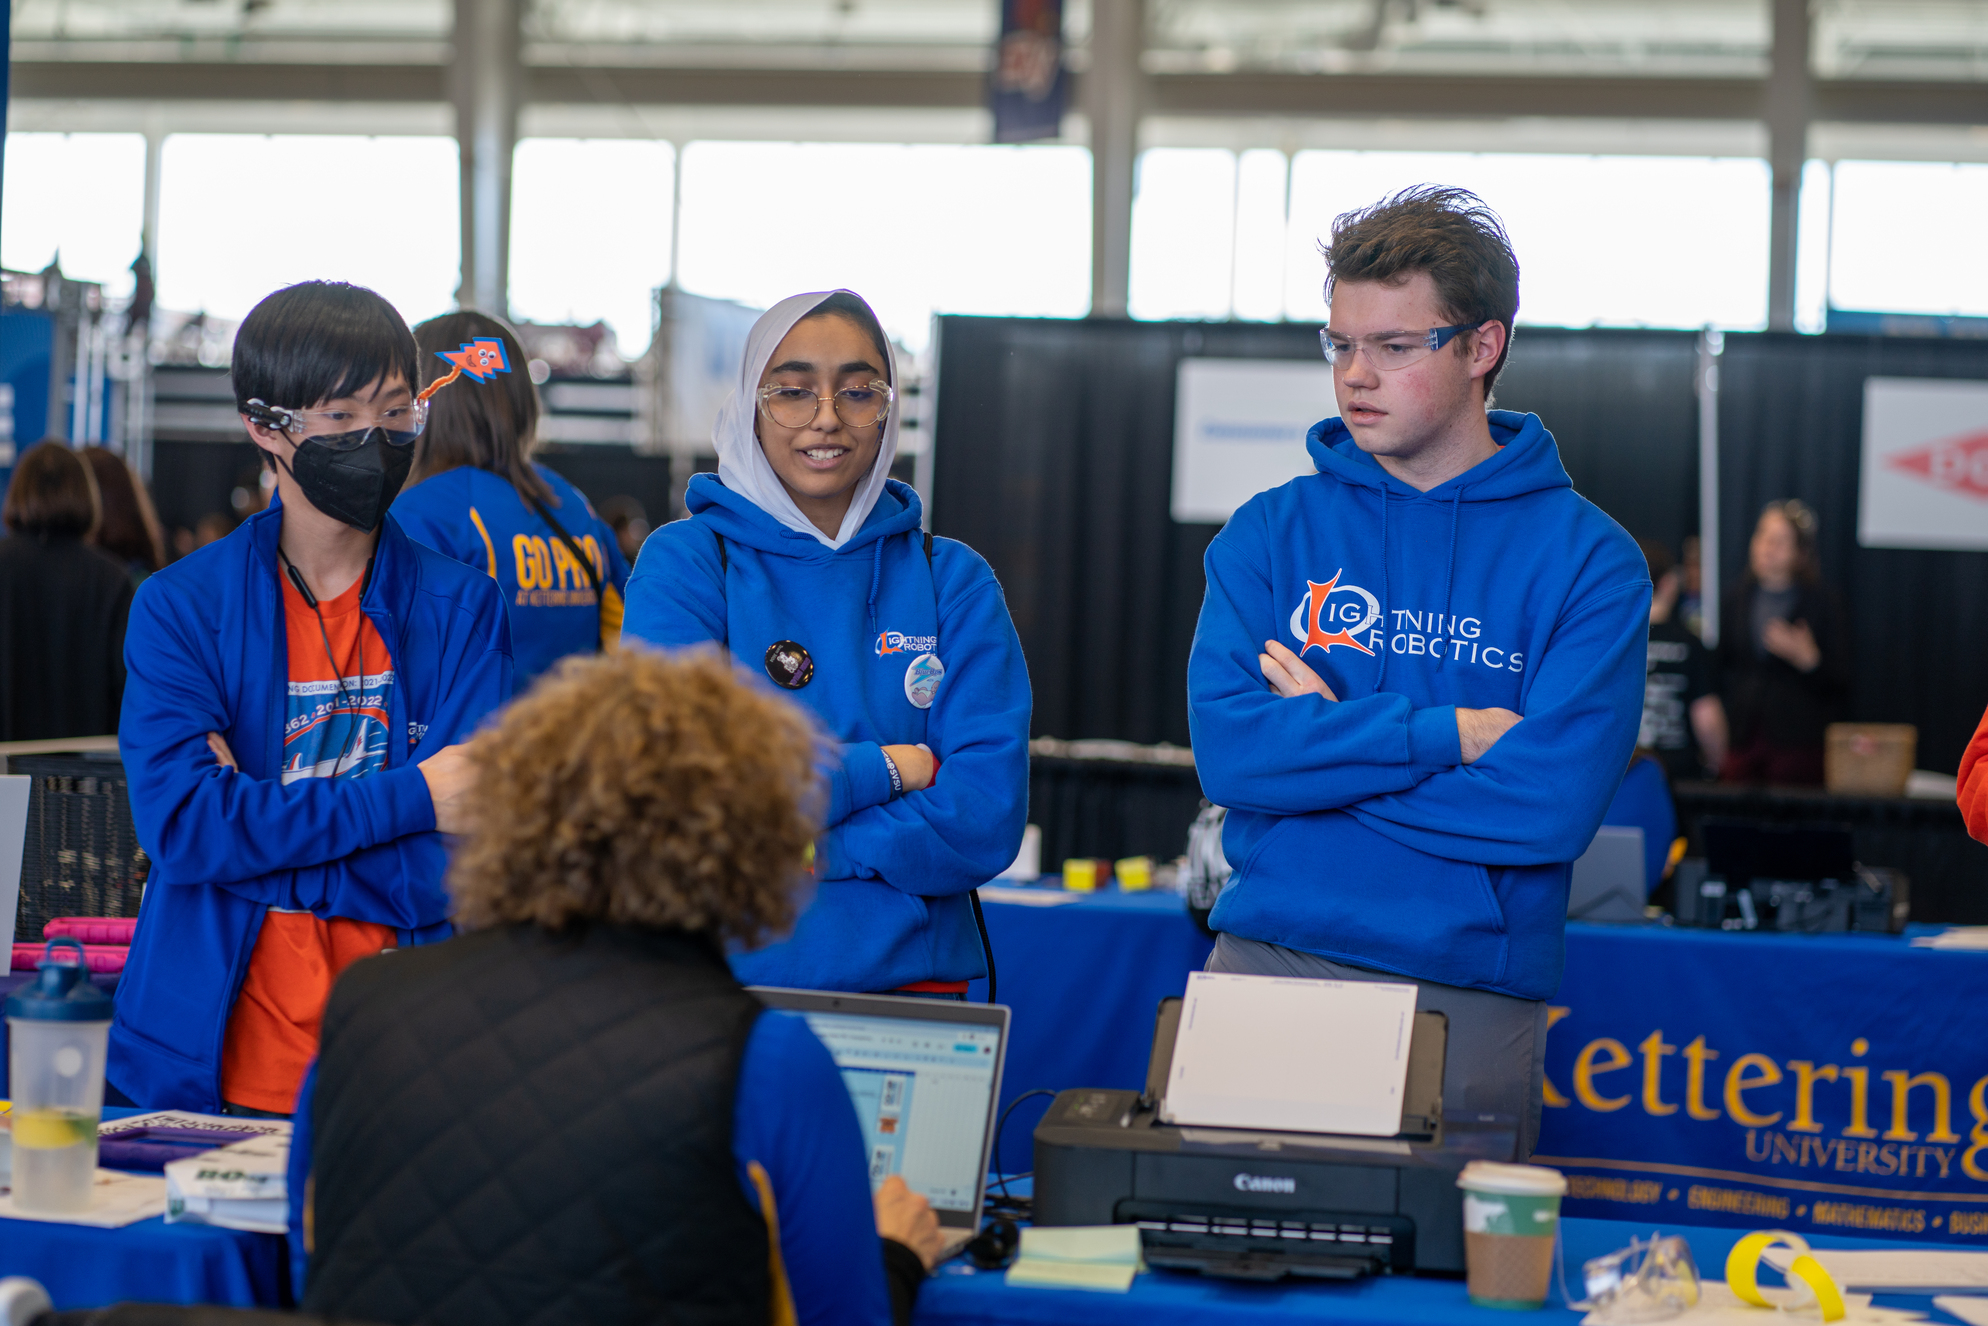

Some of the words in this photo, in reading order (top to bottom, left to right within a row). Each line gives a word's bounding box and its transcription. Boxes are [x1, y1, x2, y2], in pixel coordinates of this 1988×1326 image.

[512, 533, 553, 589] GO
[1292, 568, 1482, 657] LIGHTNING
[876, 628, 938, 657] LIGHTNING
[1368, 628, 1524, 673] ROBOTICS
[1745, 1128, 1957, 1179] UNIVERSITY
[1233, 1172, 1296, 1194] Canon
[1687, 1184, 1791, 1221] ENGINEERING
[1812, 1200, 1927, 1234] MATHEMATICS
